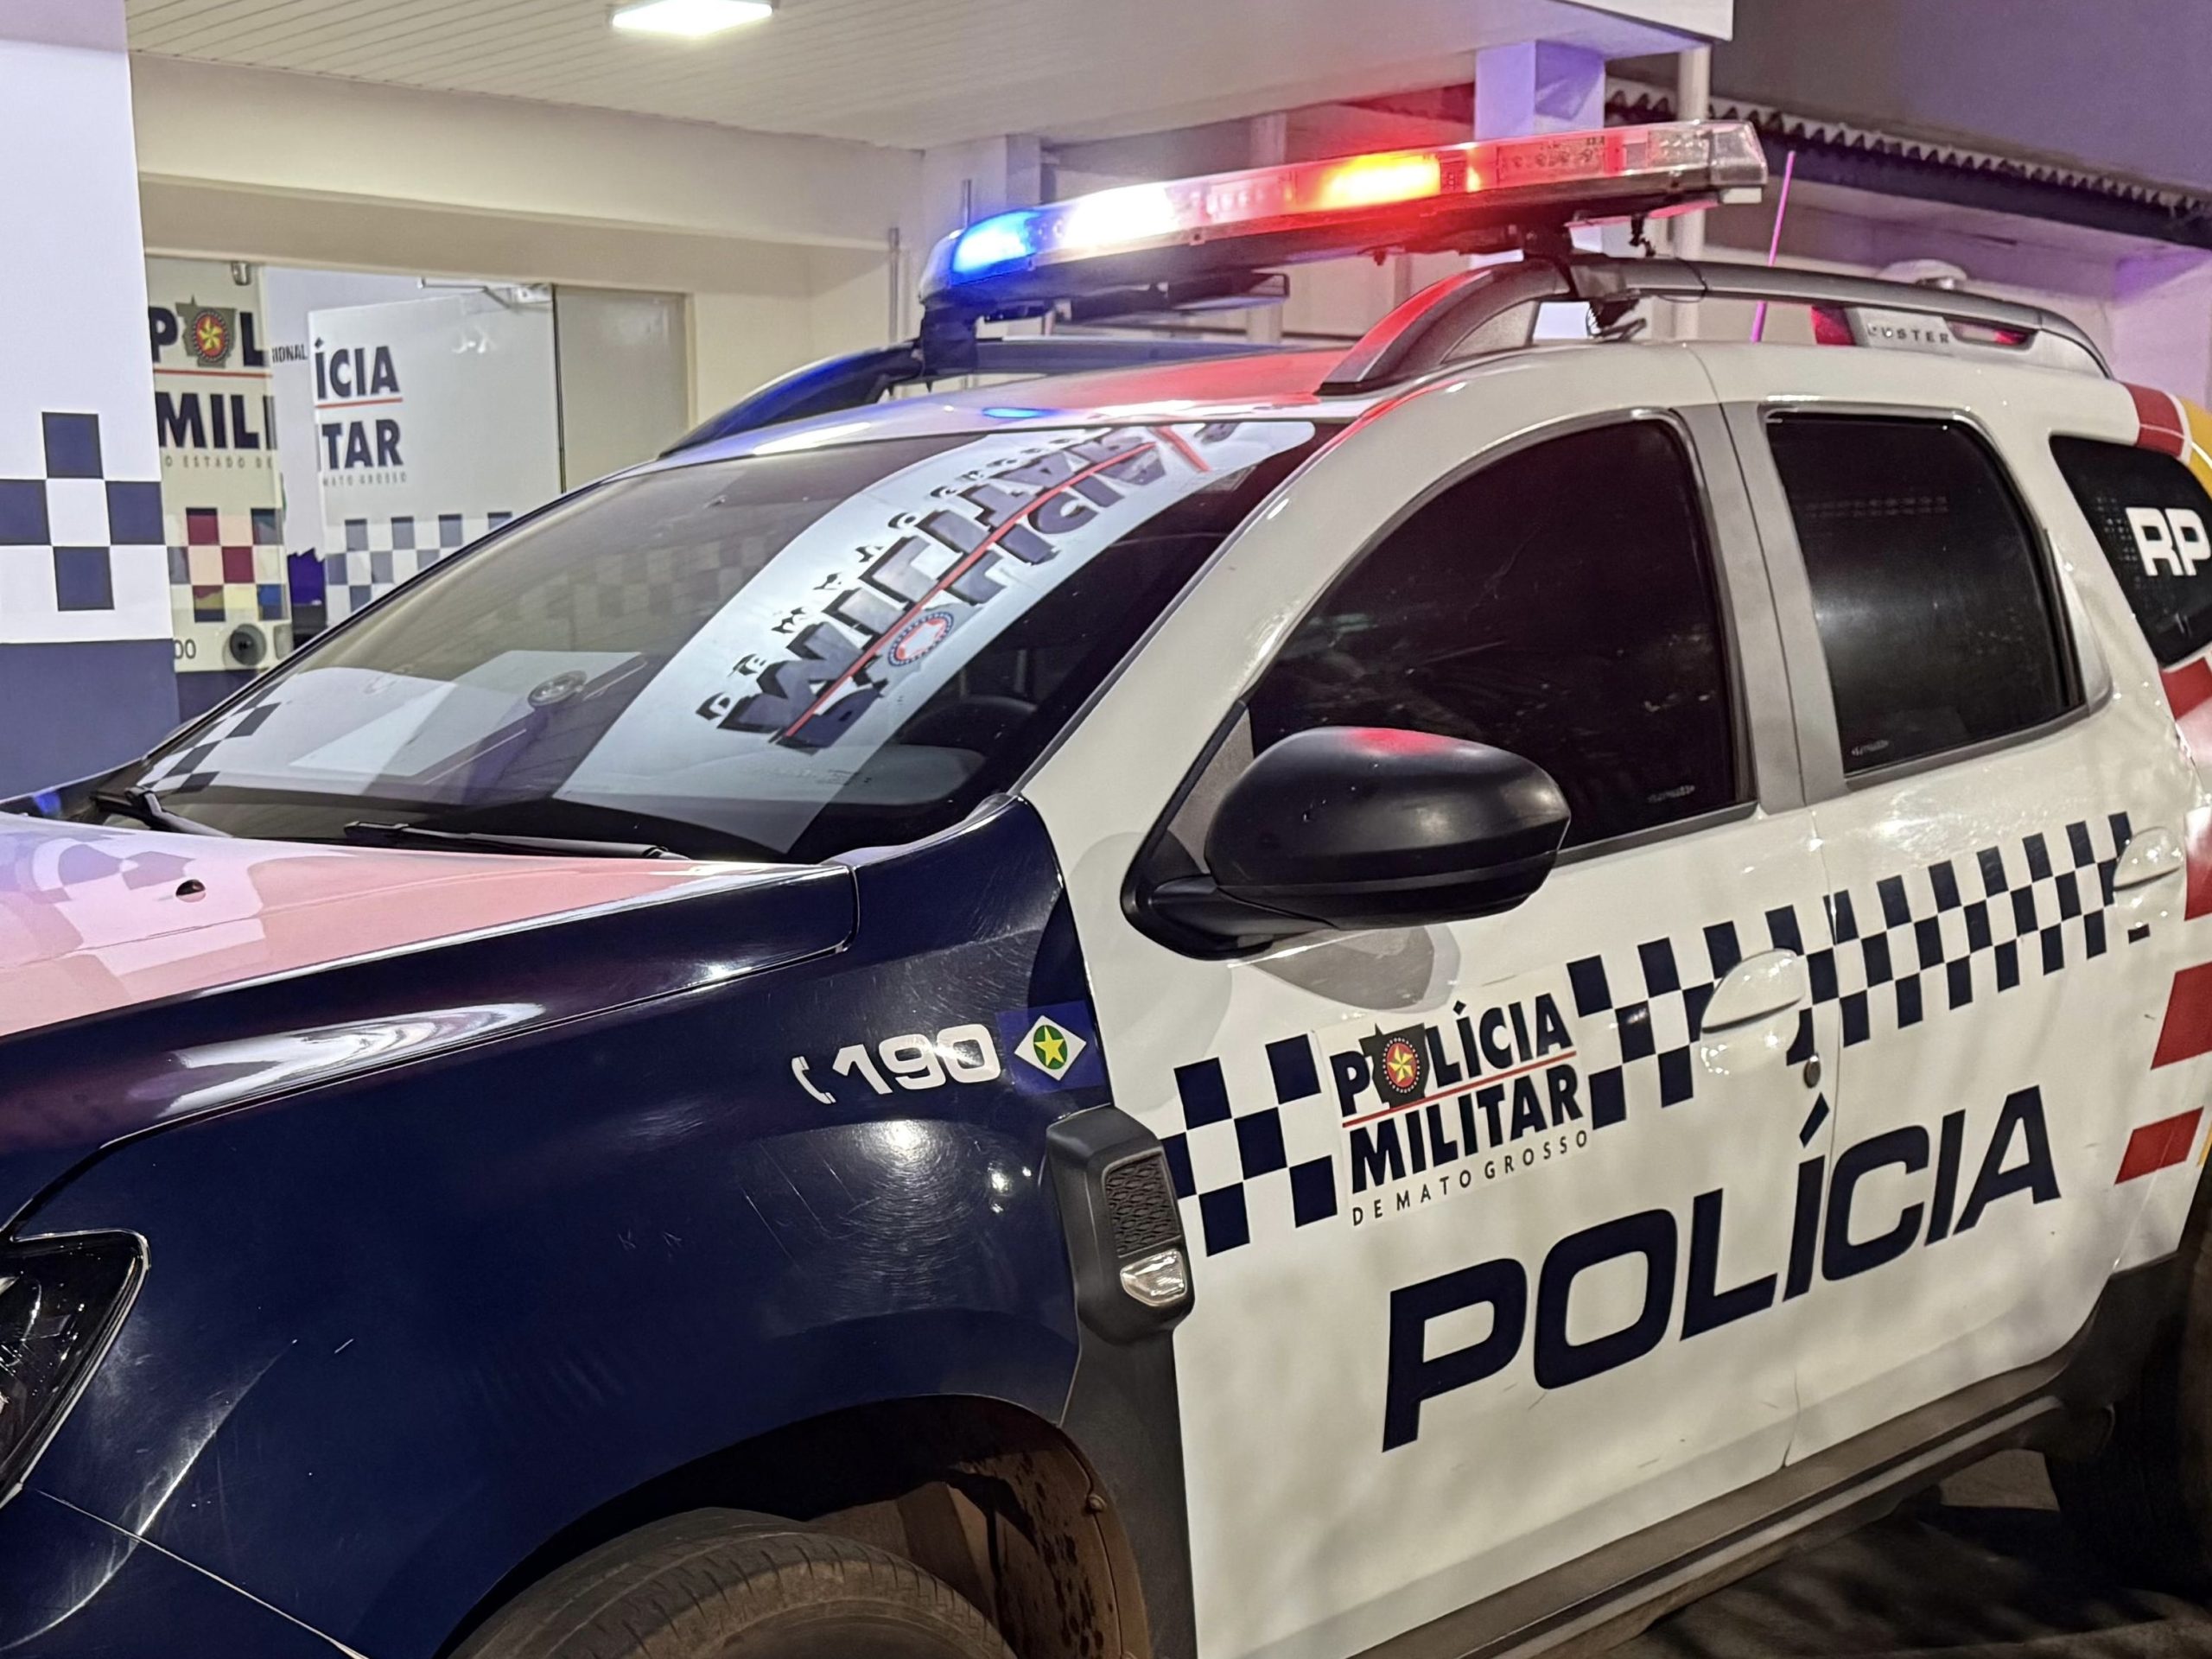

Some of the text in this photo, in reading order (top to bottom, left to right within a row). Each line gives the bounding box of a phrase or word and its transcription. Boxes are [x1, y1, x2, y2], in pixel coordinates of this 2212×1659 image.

[2126, 506, 2212, 576] RP
[832, 1023, 1001, 1095] 190
[1350, 1064, 1583, 1194] MILITAR
[1352, 1129, 1588, 1227] DE MATO GROSSO
[1382, 1084, 2062, 1453] POLÍCIA
